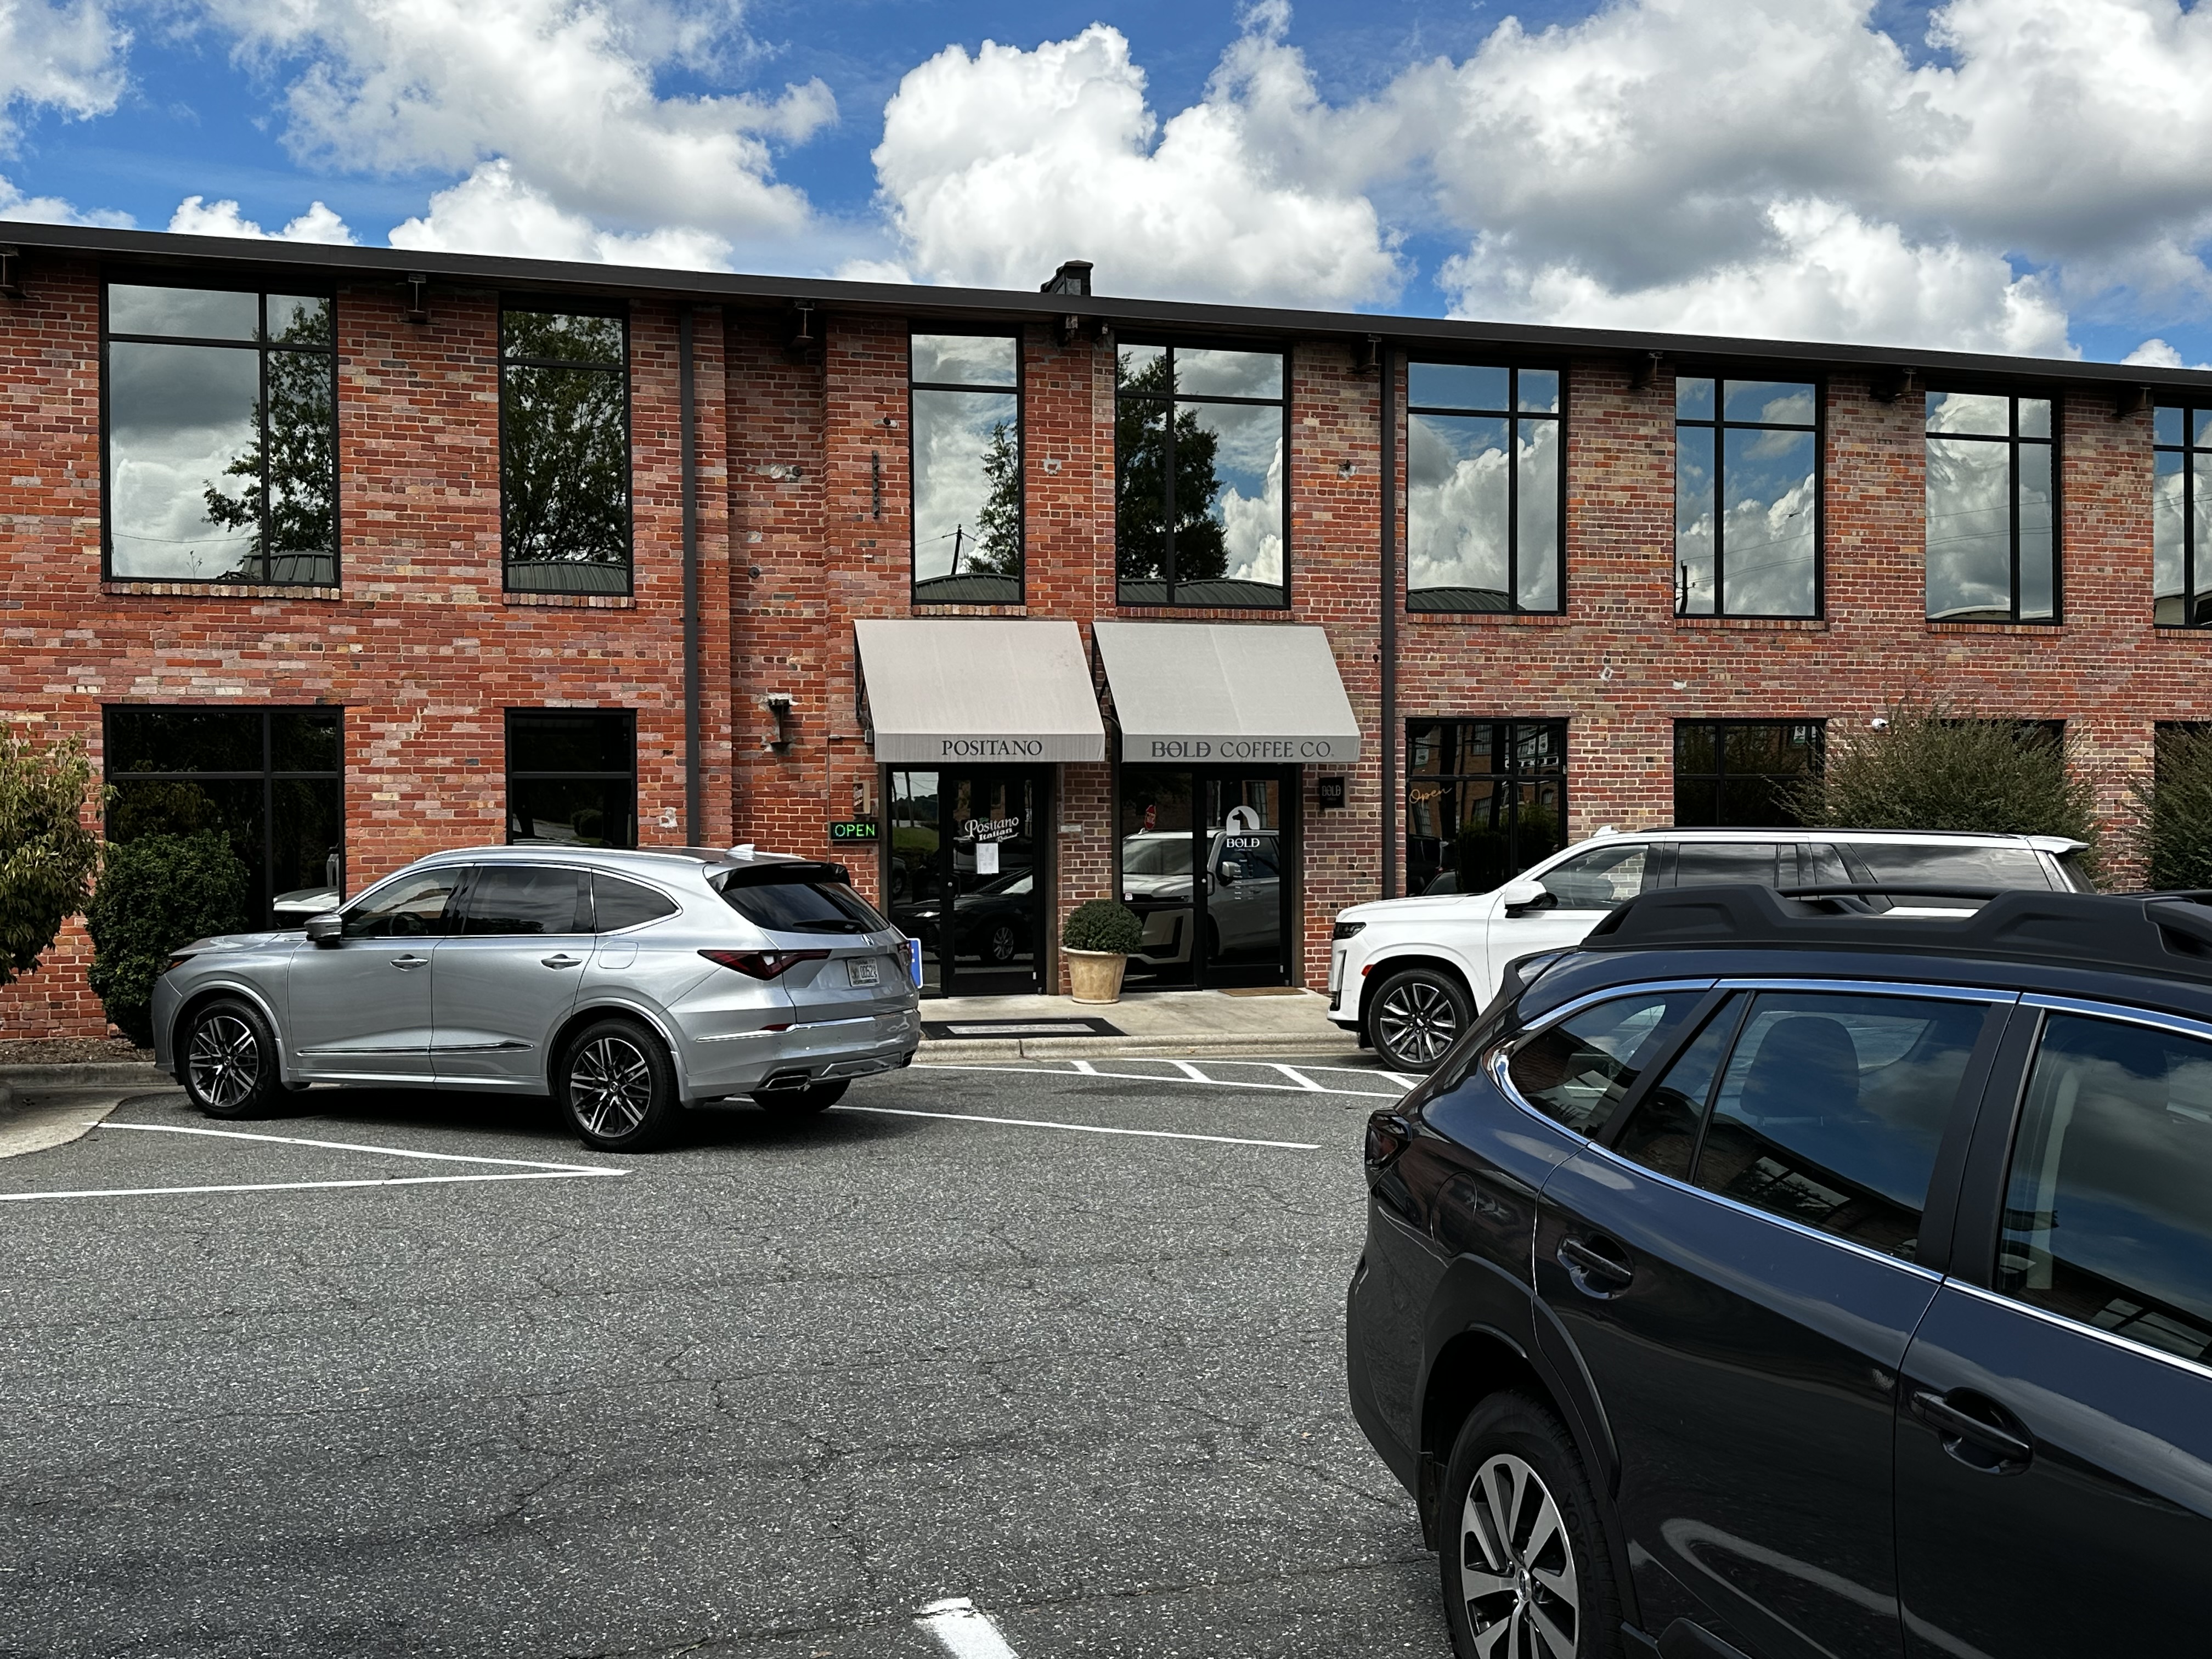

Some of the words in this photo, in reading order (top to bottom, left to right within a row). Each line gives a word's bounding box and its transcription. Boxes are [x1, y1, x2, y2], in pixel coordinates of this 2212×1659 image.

[941, 740, 1043, 755] POSITANO
[1152, 741, 1211, 758] BOLD
[1220, 741, 1294, 758] COFFEE
[1322, 785, 1341, 796] BOLD
[1409, 787, 1453, 809] Open
[835, 824, 875, 837] OPEN
[964, 817, 1019, 838] Positano
[979, 827, 1012, 842] Italian
[1227, 838, 1260, 848] BOLD
